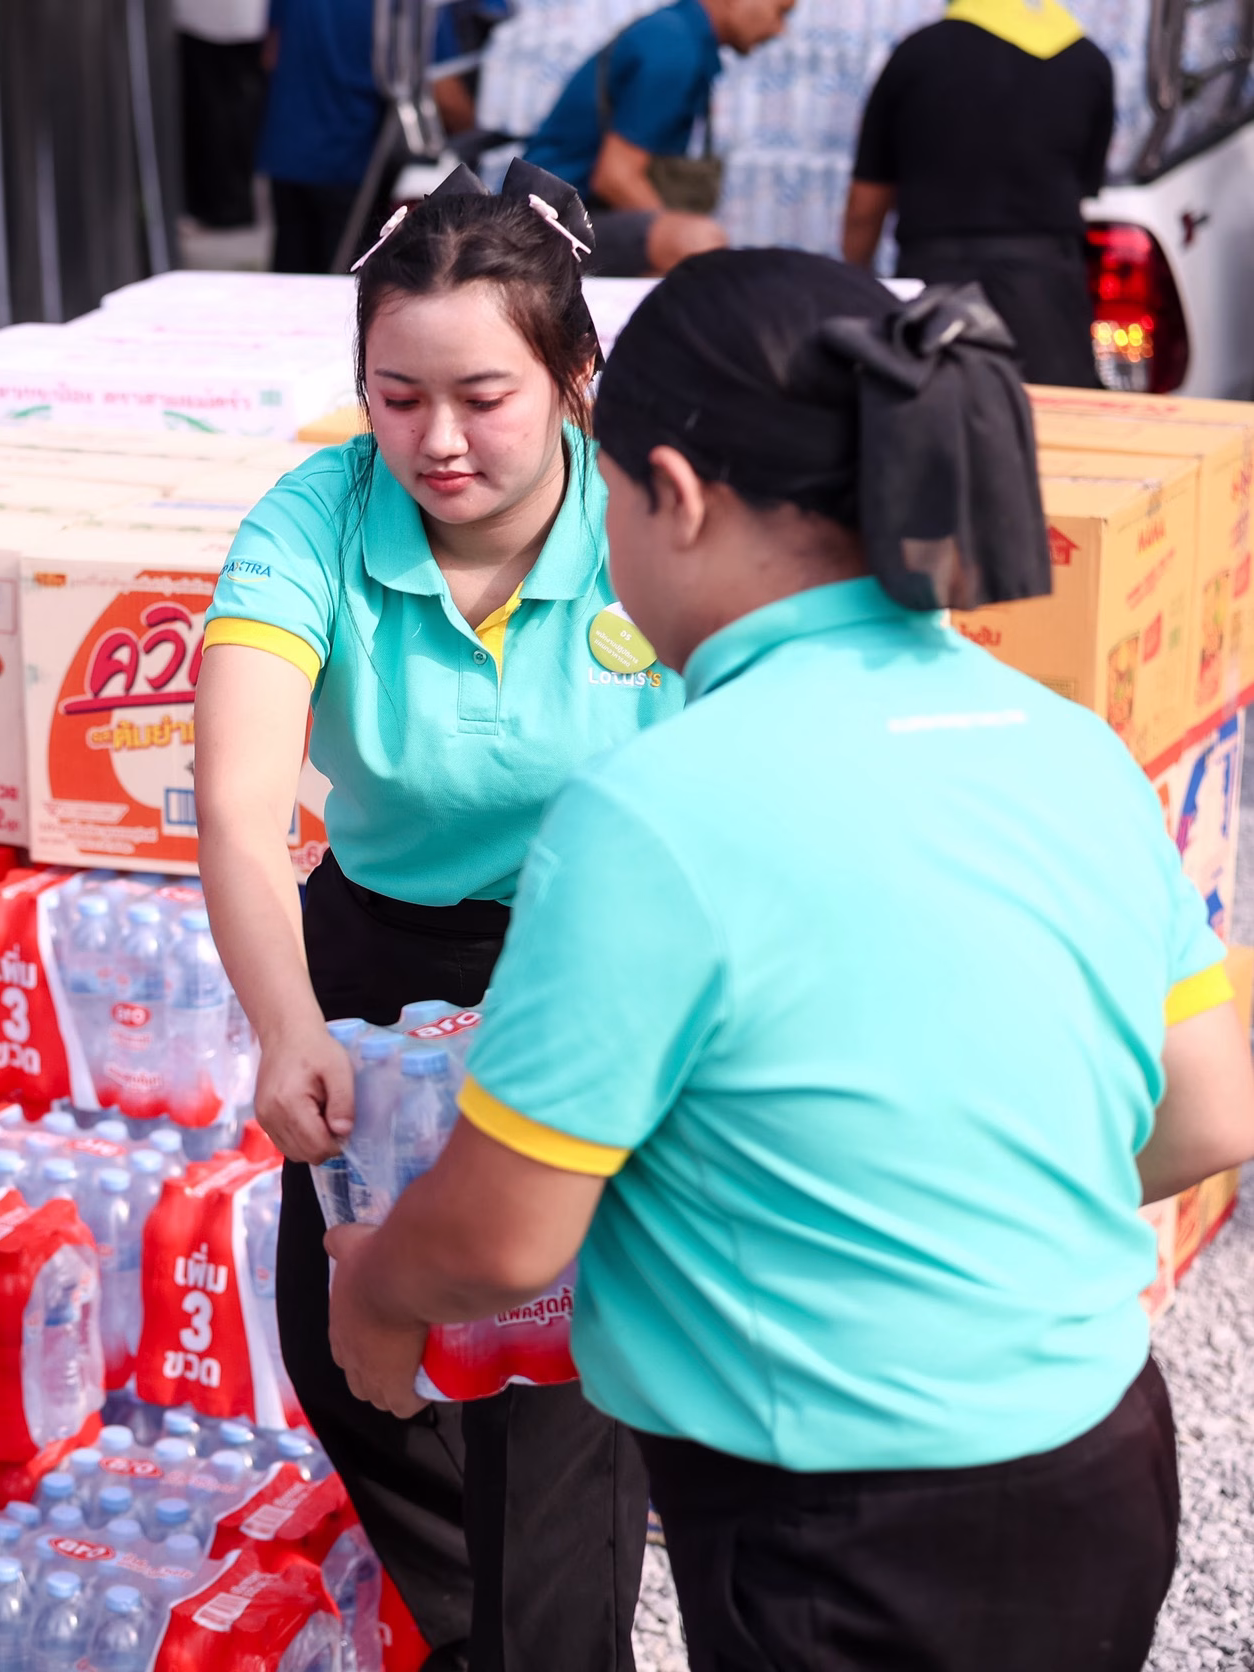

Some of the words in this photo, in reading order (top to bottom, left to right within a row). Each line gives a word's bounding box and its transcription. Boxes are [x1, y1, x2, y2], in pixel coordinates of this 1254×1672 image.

[90, 605, 202, 698] ควิ
[1, 986, 31, 1044] 3
[174, 1242, 228, 1294] เพิ่ม
[179, 1290, 213, 1353] 3
[497, 1287, 573, 1323] แพคสุดคุ้
[162, 1350, 221, 1388] ขวด
